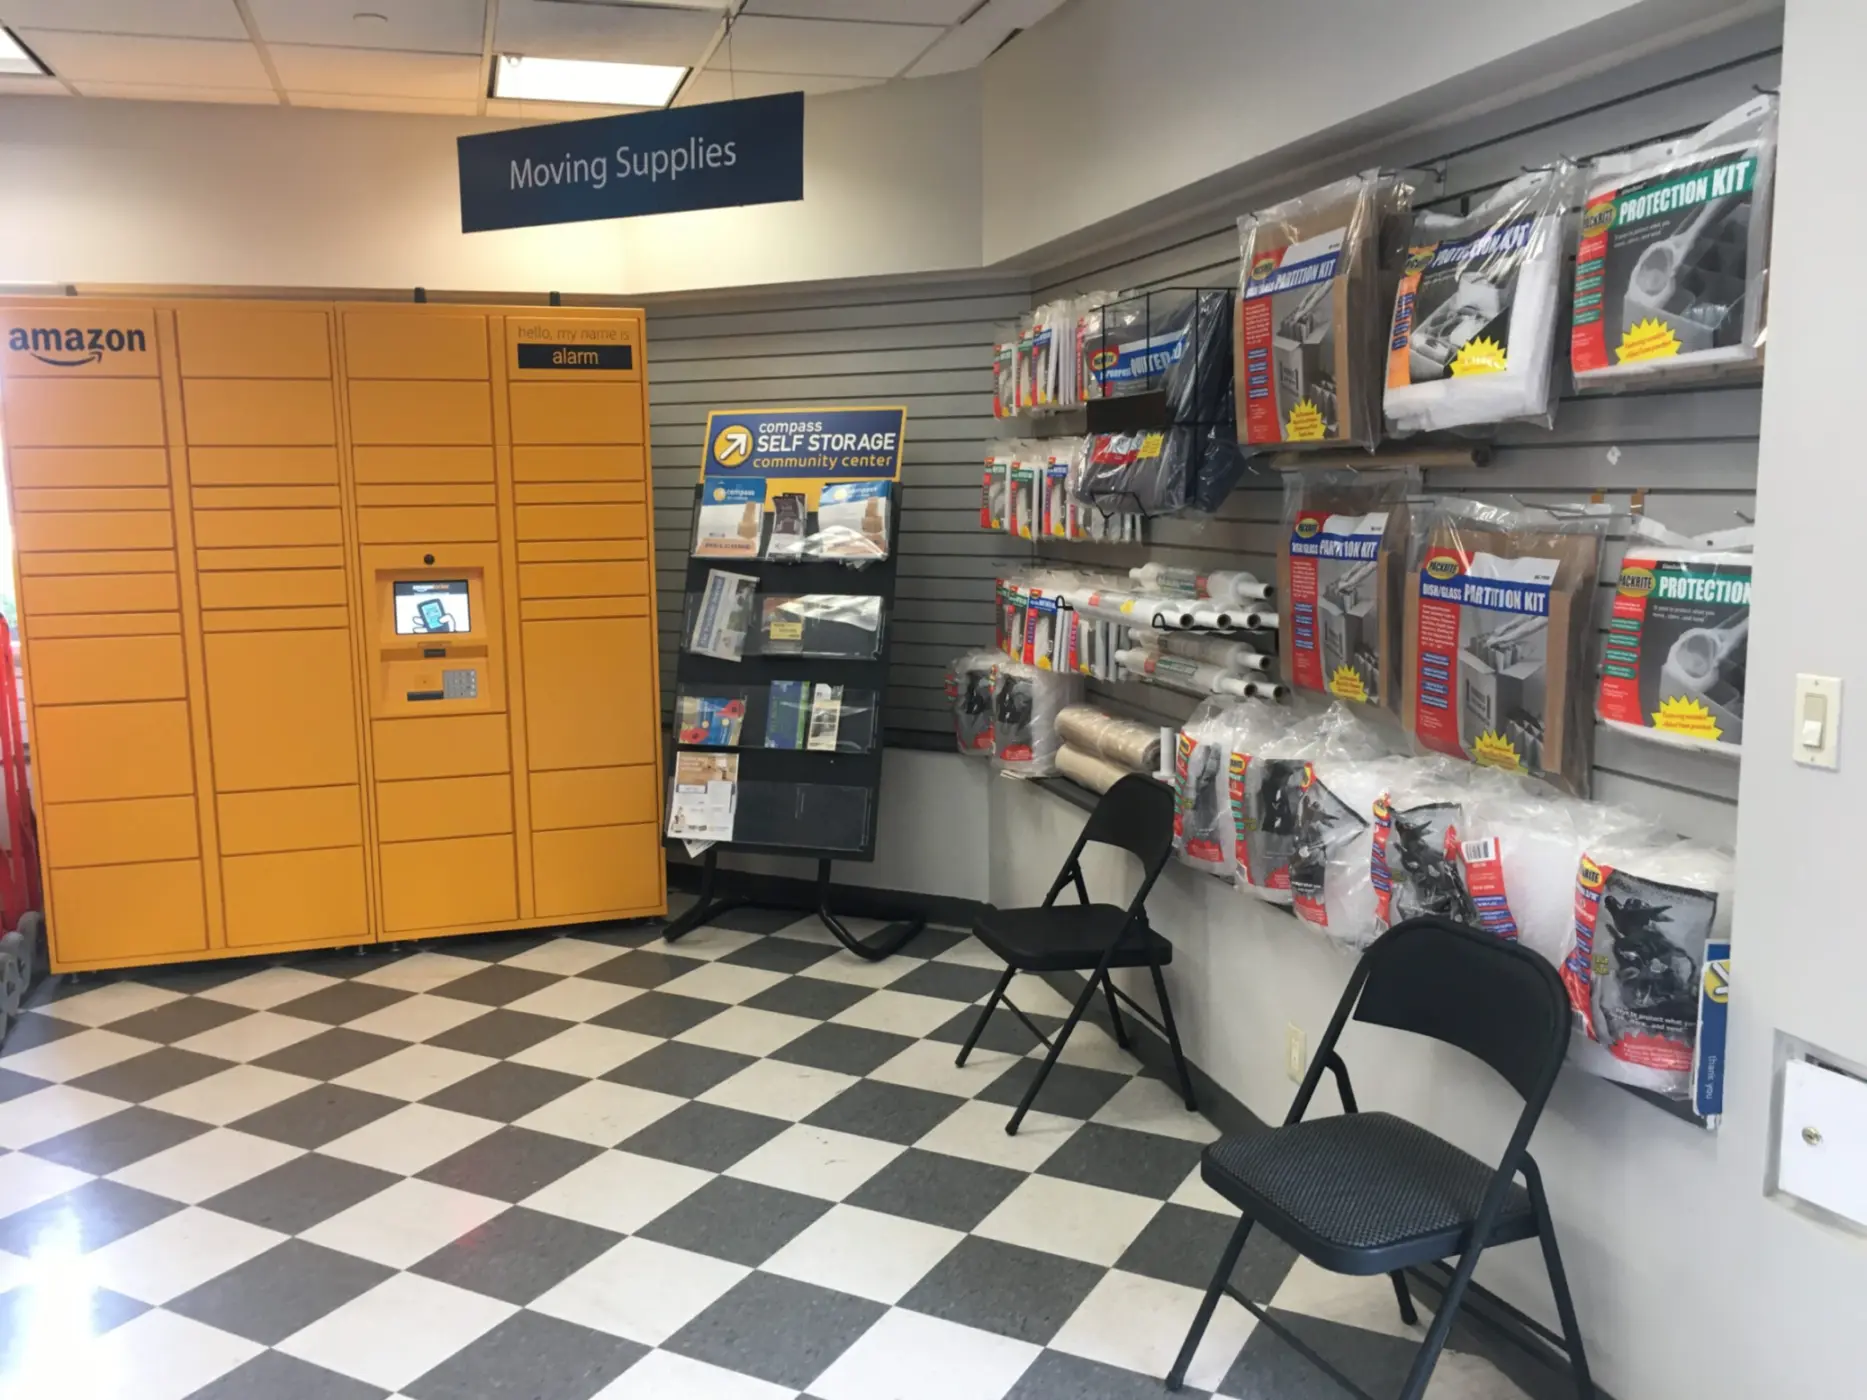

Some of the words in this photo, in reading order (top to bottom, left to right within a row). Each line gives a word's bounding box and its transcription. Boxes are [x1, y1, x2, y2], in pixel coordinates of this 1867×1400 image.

[510, 153, 607, 189] Moving
[616, 137, 737, 182] Supplies
[1619, 177, 1708, 225] PROTECTION
[1712, 160, 1750, 198] KIT
[1274, 263, 1319, 291] PARTITION
[1318, 258, 1337, 279] KIT
[9, 327, 146, 352] amazon
[518, 325, 553, 341] hello,
[557, 328, 577, 343] my
[581, 328, 617, 340] name
[620, 329, 630, 341] is
[552, 347, 600, 365] alarm
[758, 420, 822, 437] compass
[757, 434, 804, 452] SELF
[808, 432, 896, 451] STORAGE
[753, 454, 838, 470] community
[841, 455, 892, 467] center
[1361, 541, 1378, 558] KIT
[1422, 583, 1461, 601] DISH/GLASS
[1463, 583, 1522, 610] PARTITION
[1524, 590, 1546, 613] KIT
[1619, 575, 1653, 589] PACKRITE
[1658, 575, 1751, 605] PROTECTION
[1704, 1080, 1714, 1100] you
